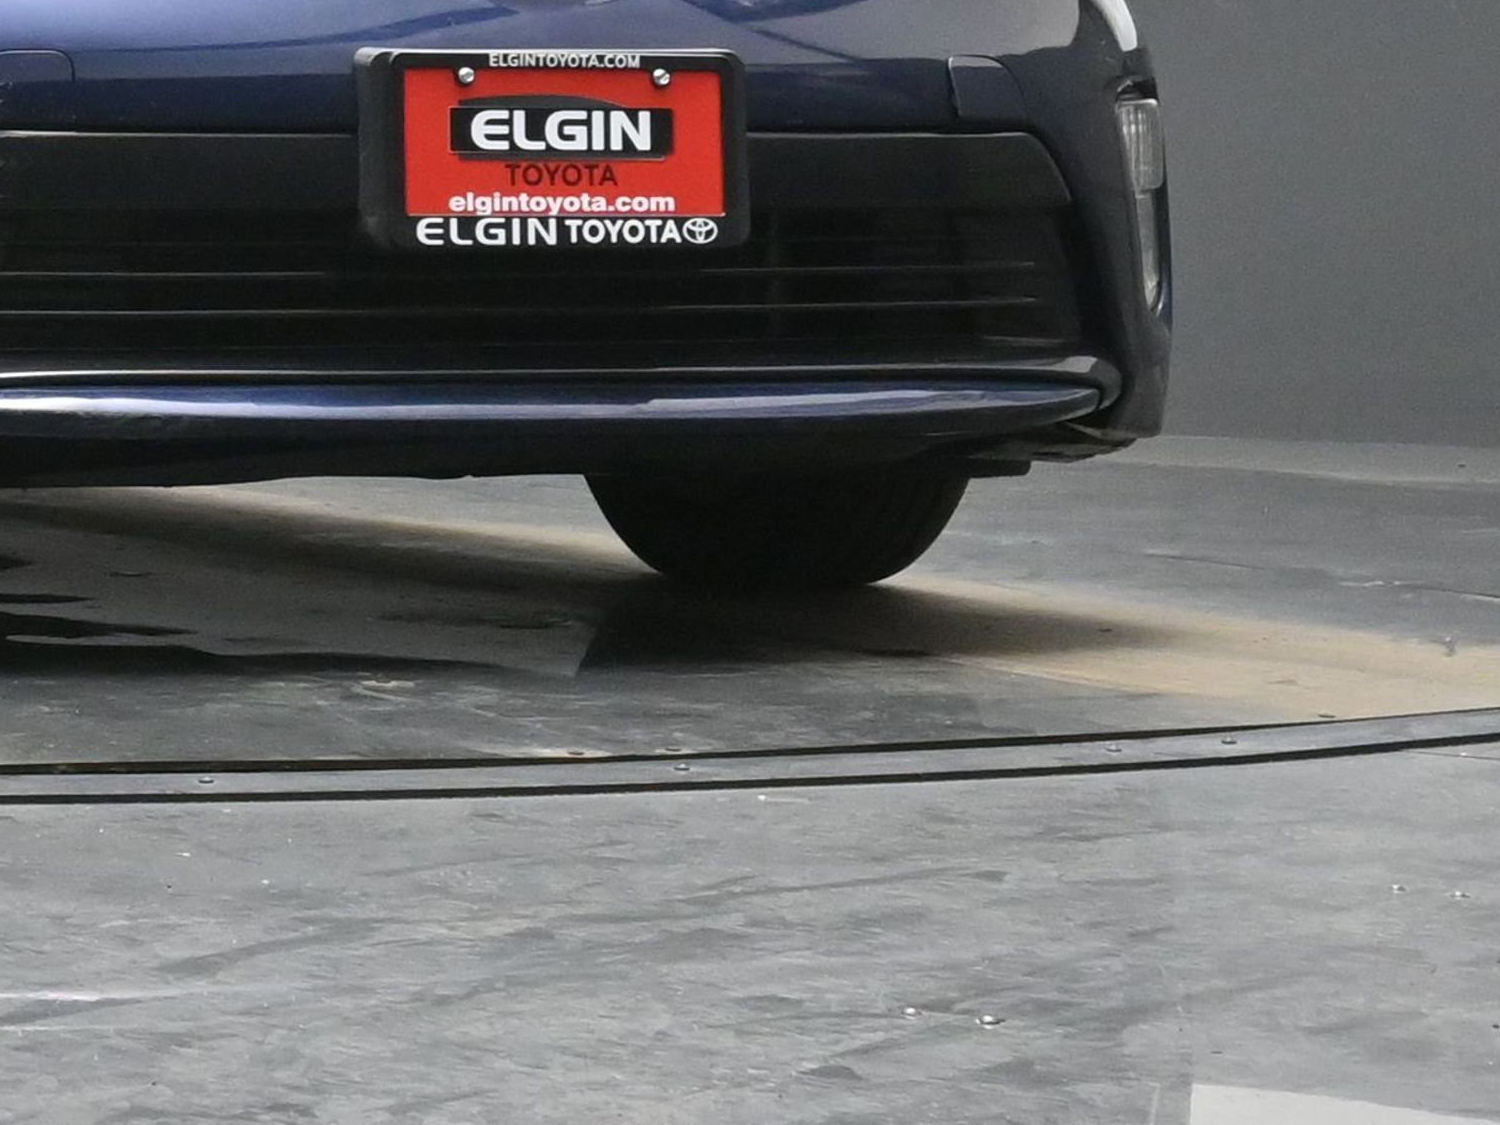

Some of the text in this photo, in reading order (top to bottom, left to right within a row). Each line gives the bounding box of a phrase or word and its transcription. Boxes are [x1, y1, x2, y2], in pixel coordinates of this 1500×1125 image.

[488, 53, 640, 69] ELGINTOYOTA.COM
[470, 109, 651, 151] ELGIN
[506, 164, 618, 186] TOYOTA
[448, 192, 676, 216] elgintoyota.com
[416, 218, 682, 246] ELGIN TOYOTA
